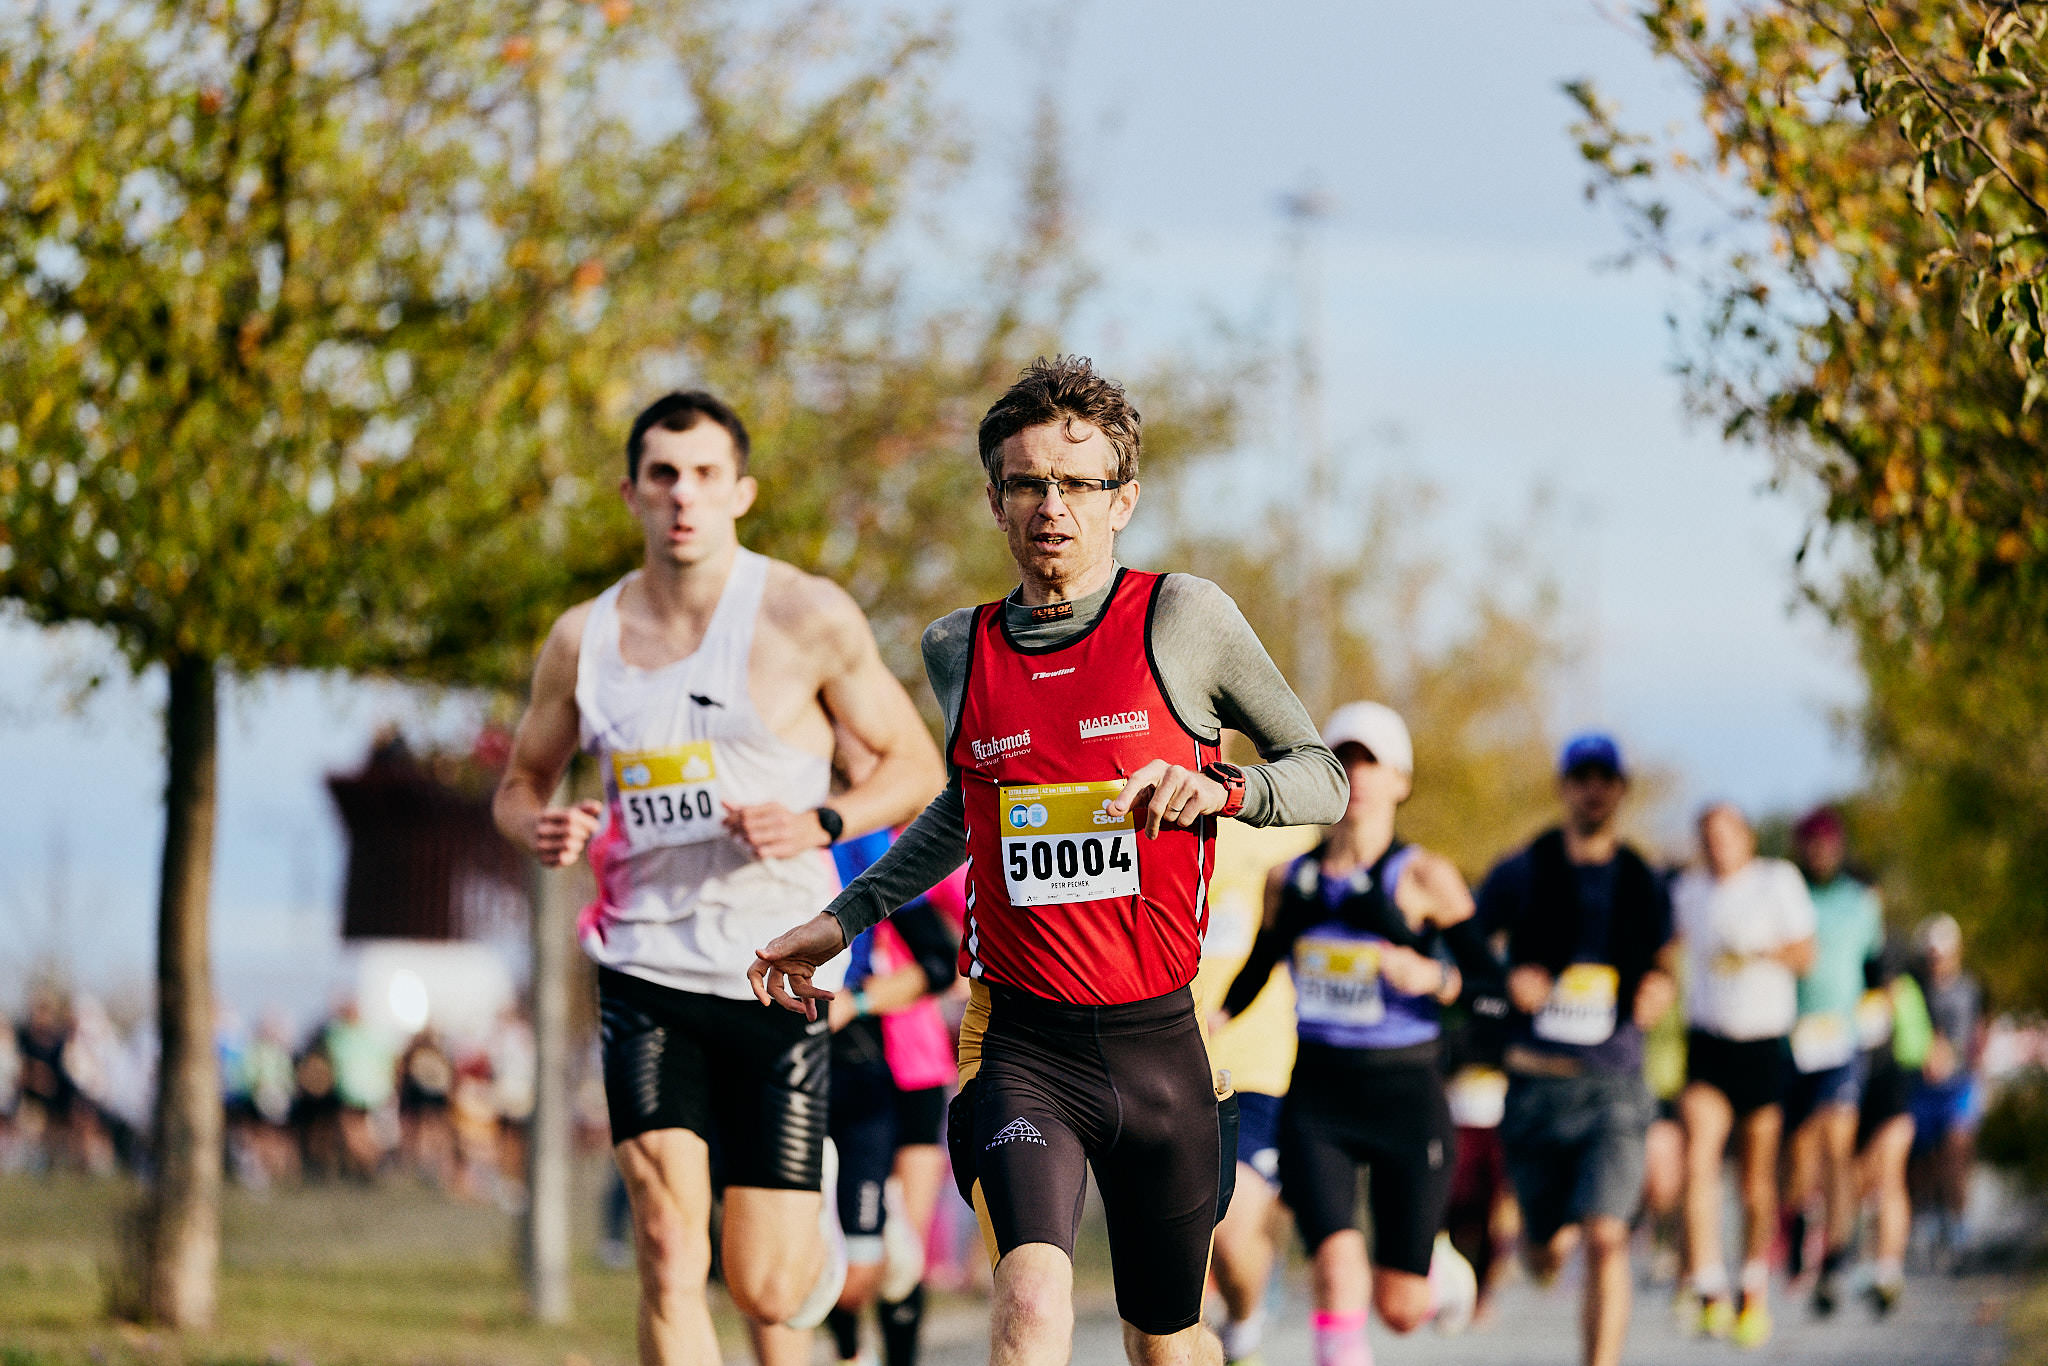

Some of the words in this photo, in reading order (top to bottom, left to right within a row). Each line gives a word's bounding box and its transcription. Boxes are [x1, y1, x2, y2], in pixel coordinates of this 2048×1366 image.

[1079, 710, 1149, 731] MARATON
[971, 729, 1031, 760] Krakonoš
[1001, 748, 1032, 759] Trutnov
[629, 789, 712, 826] 51360
[1008, 836, 1132, 882] 50004
[1051, 881, 1066, 889] PETR
[985, 1136, 1016, 1151] CRAFT
[1019, 1136, 1048, 1147] TRAIL
